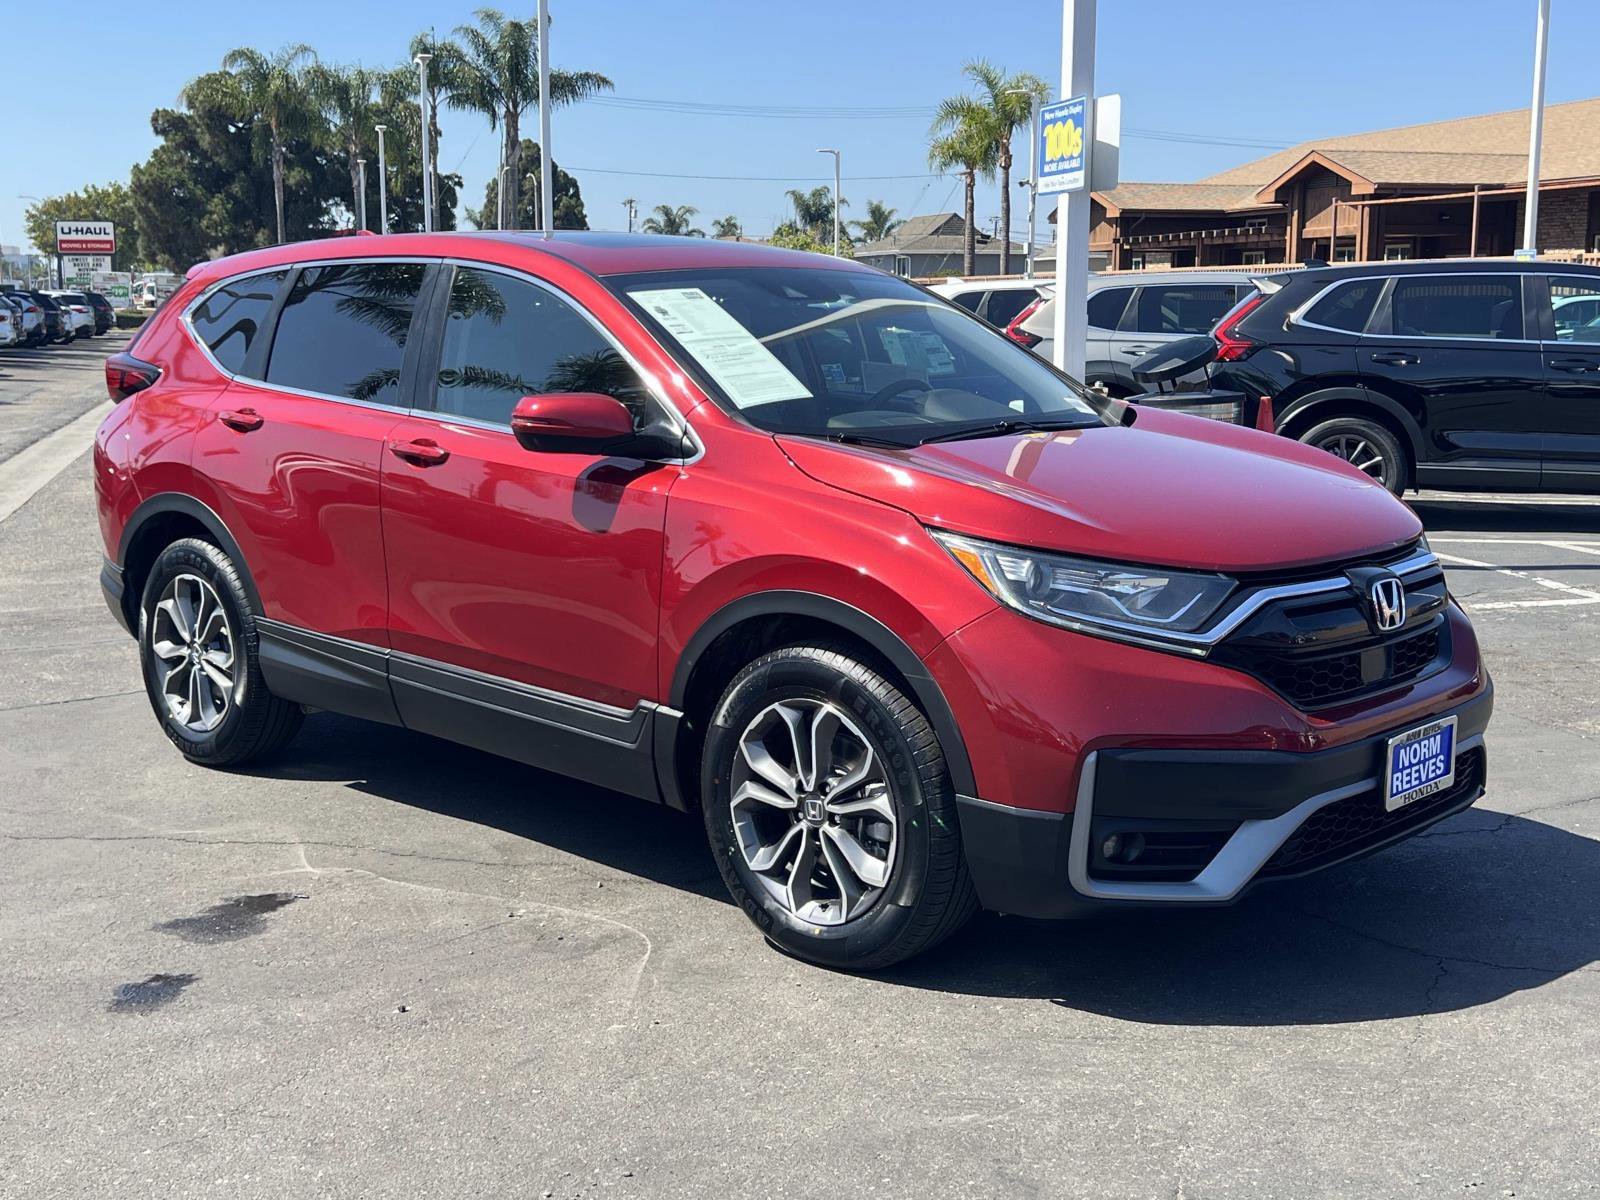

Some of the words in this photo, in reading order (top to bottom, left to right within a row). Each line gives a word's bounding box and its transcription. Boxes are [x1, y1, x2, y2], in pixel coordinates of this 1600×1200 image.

[61, 227, 110, 235] U-HAUL
[1399, 735, 1441, 769] NORM
[1392, 755, 1445, 794] REEVES
